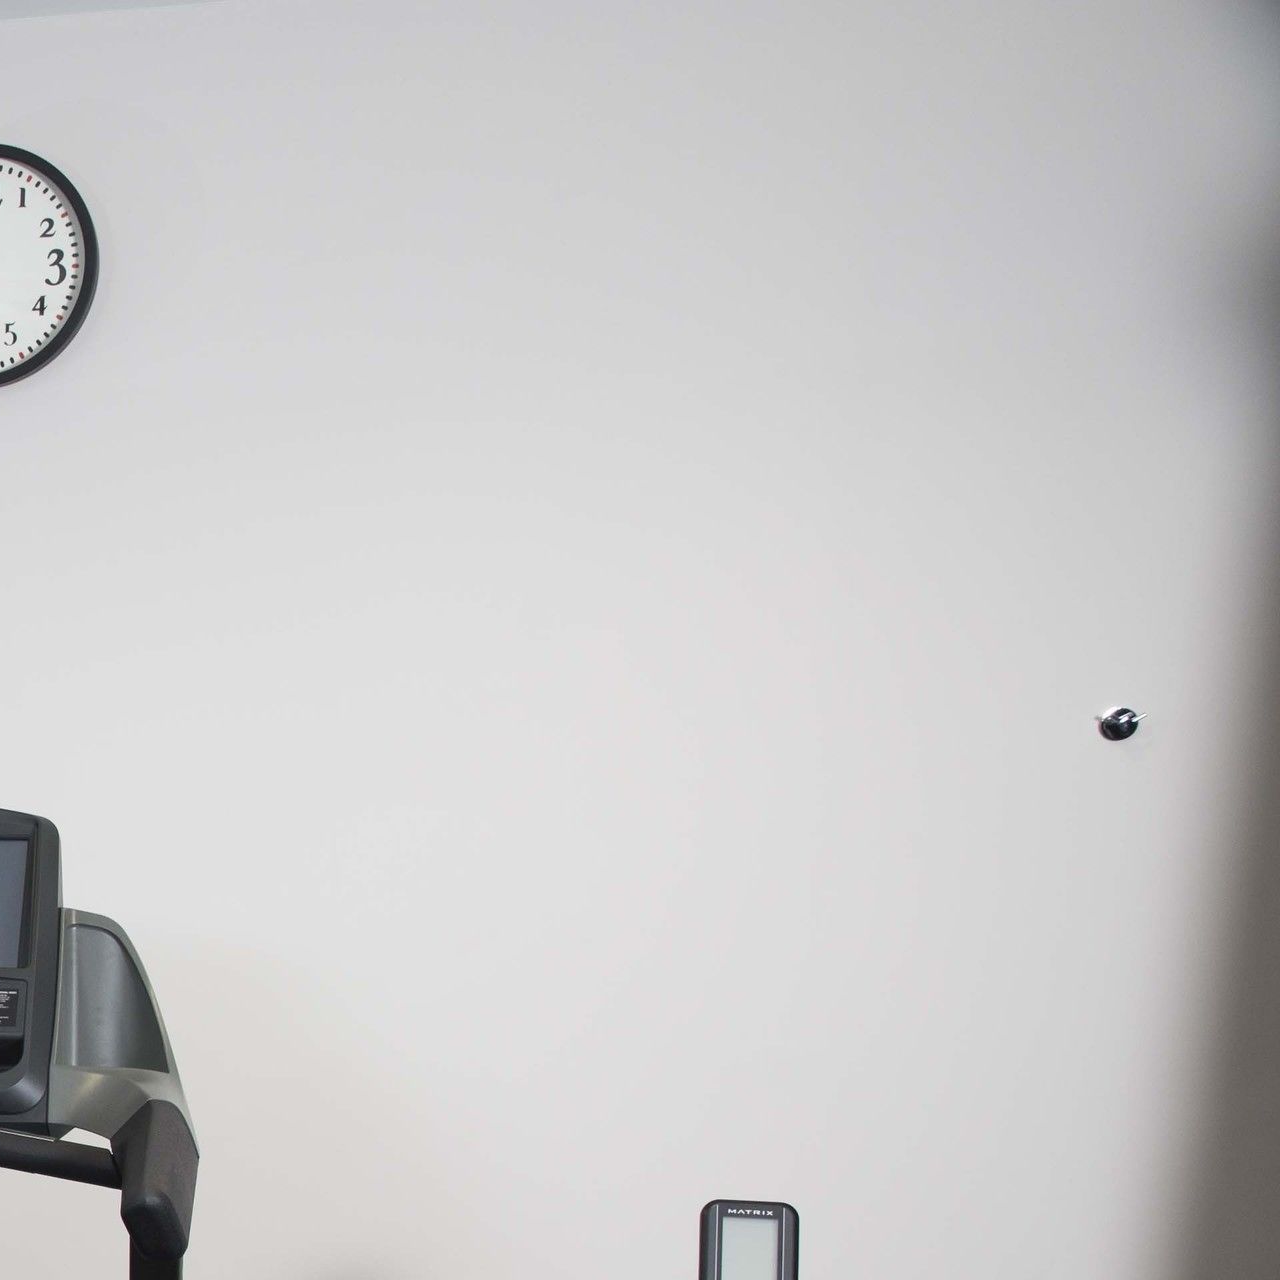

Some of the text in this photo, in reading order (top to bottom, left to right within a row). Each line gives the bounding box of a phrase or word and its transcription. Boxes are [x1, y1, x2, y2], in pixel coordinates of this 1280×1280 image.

[18, 187, 26, 208] 1
[40, 218, 56, 238] 2
[44, 248, 67, 286] 3
[32, 295, 48, 316] 4
[4, 321, 18, 346] 5
[727, 1208, 774, 1216] MATRIX
